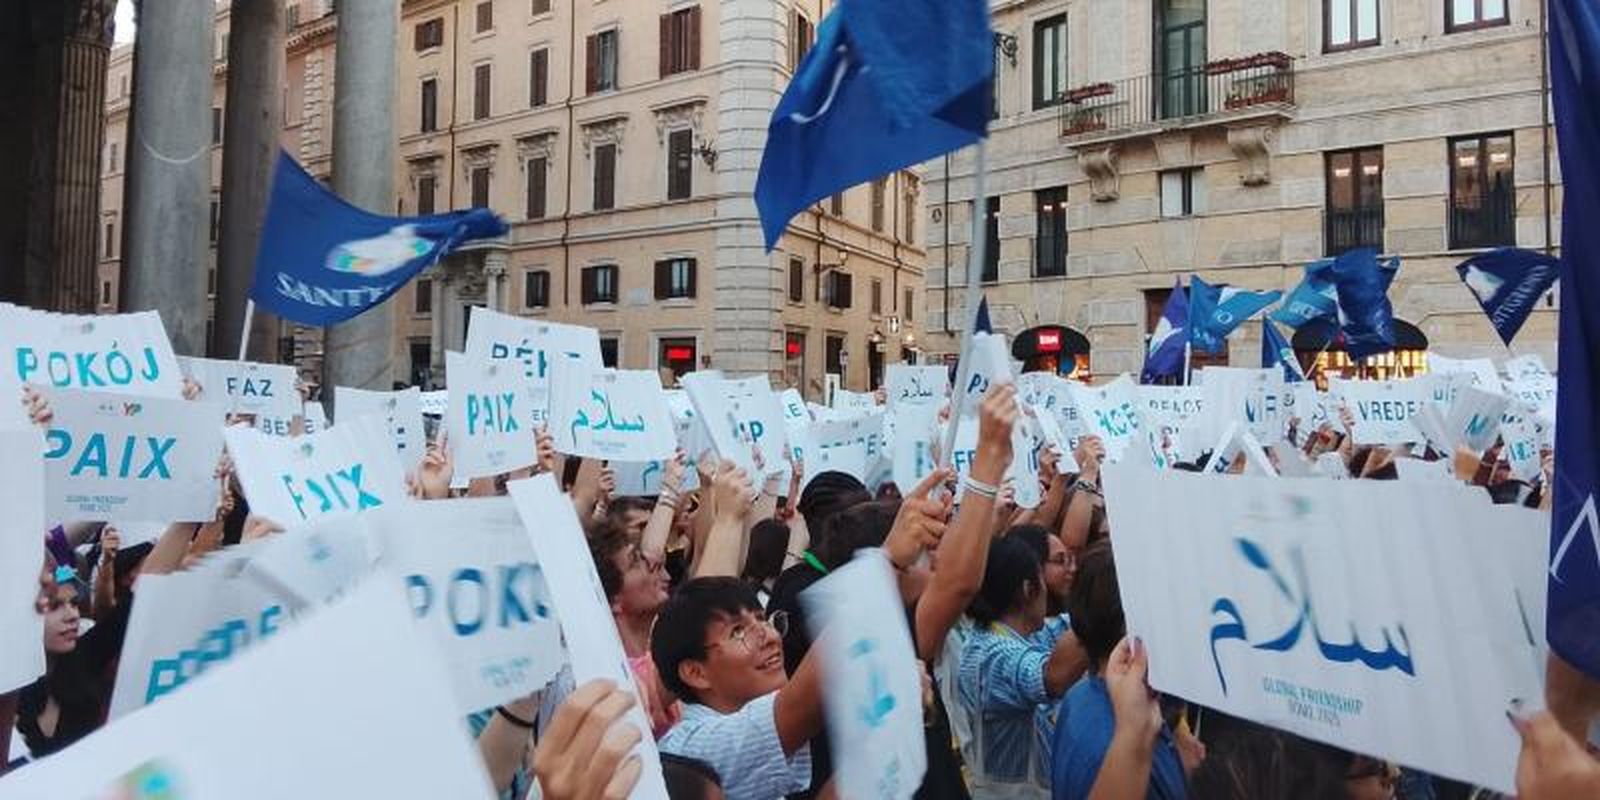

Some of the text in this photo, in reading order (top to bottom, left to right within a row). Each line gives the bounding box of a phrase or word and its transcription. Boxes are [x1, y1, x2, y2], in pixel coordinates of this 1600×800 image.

[15, 341, 160, 388] POKÓJ
[570, 389, 645, 448] سلام
[43, 429, 177, 480] PAIX
[1210, 536, 1416, 698] سلام
